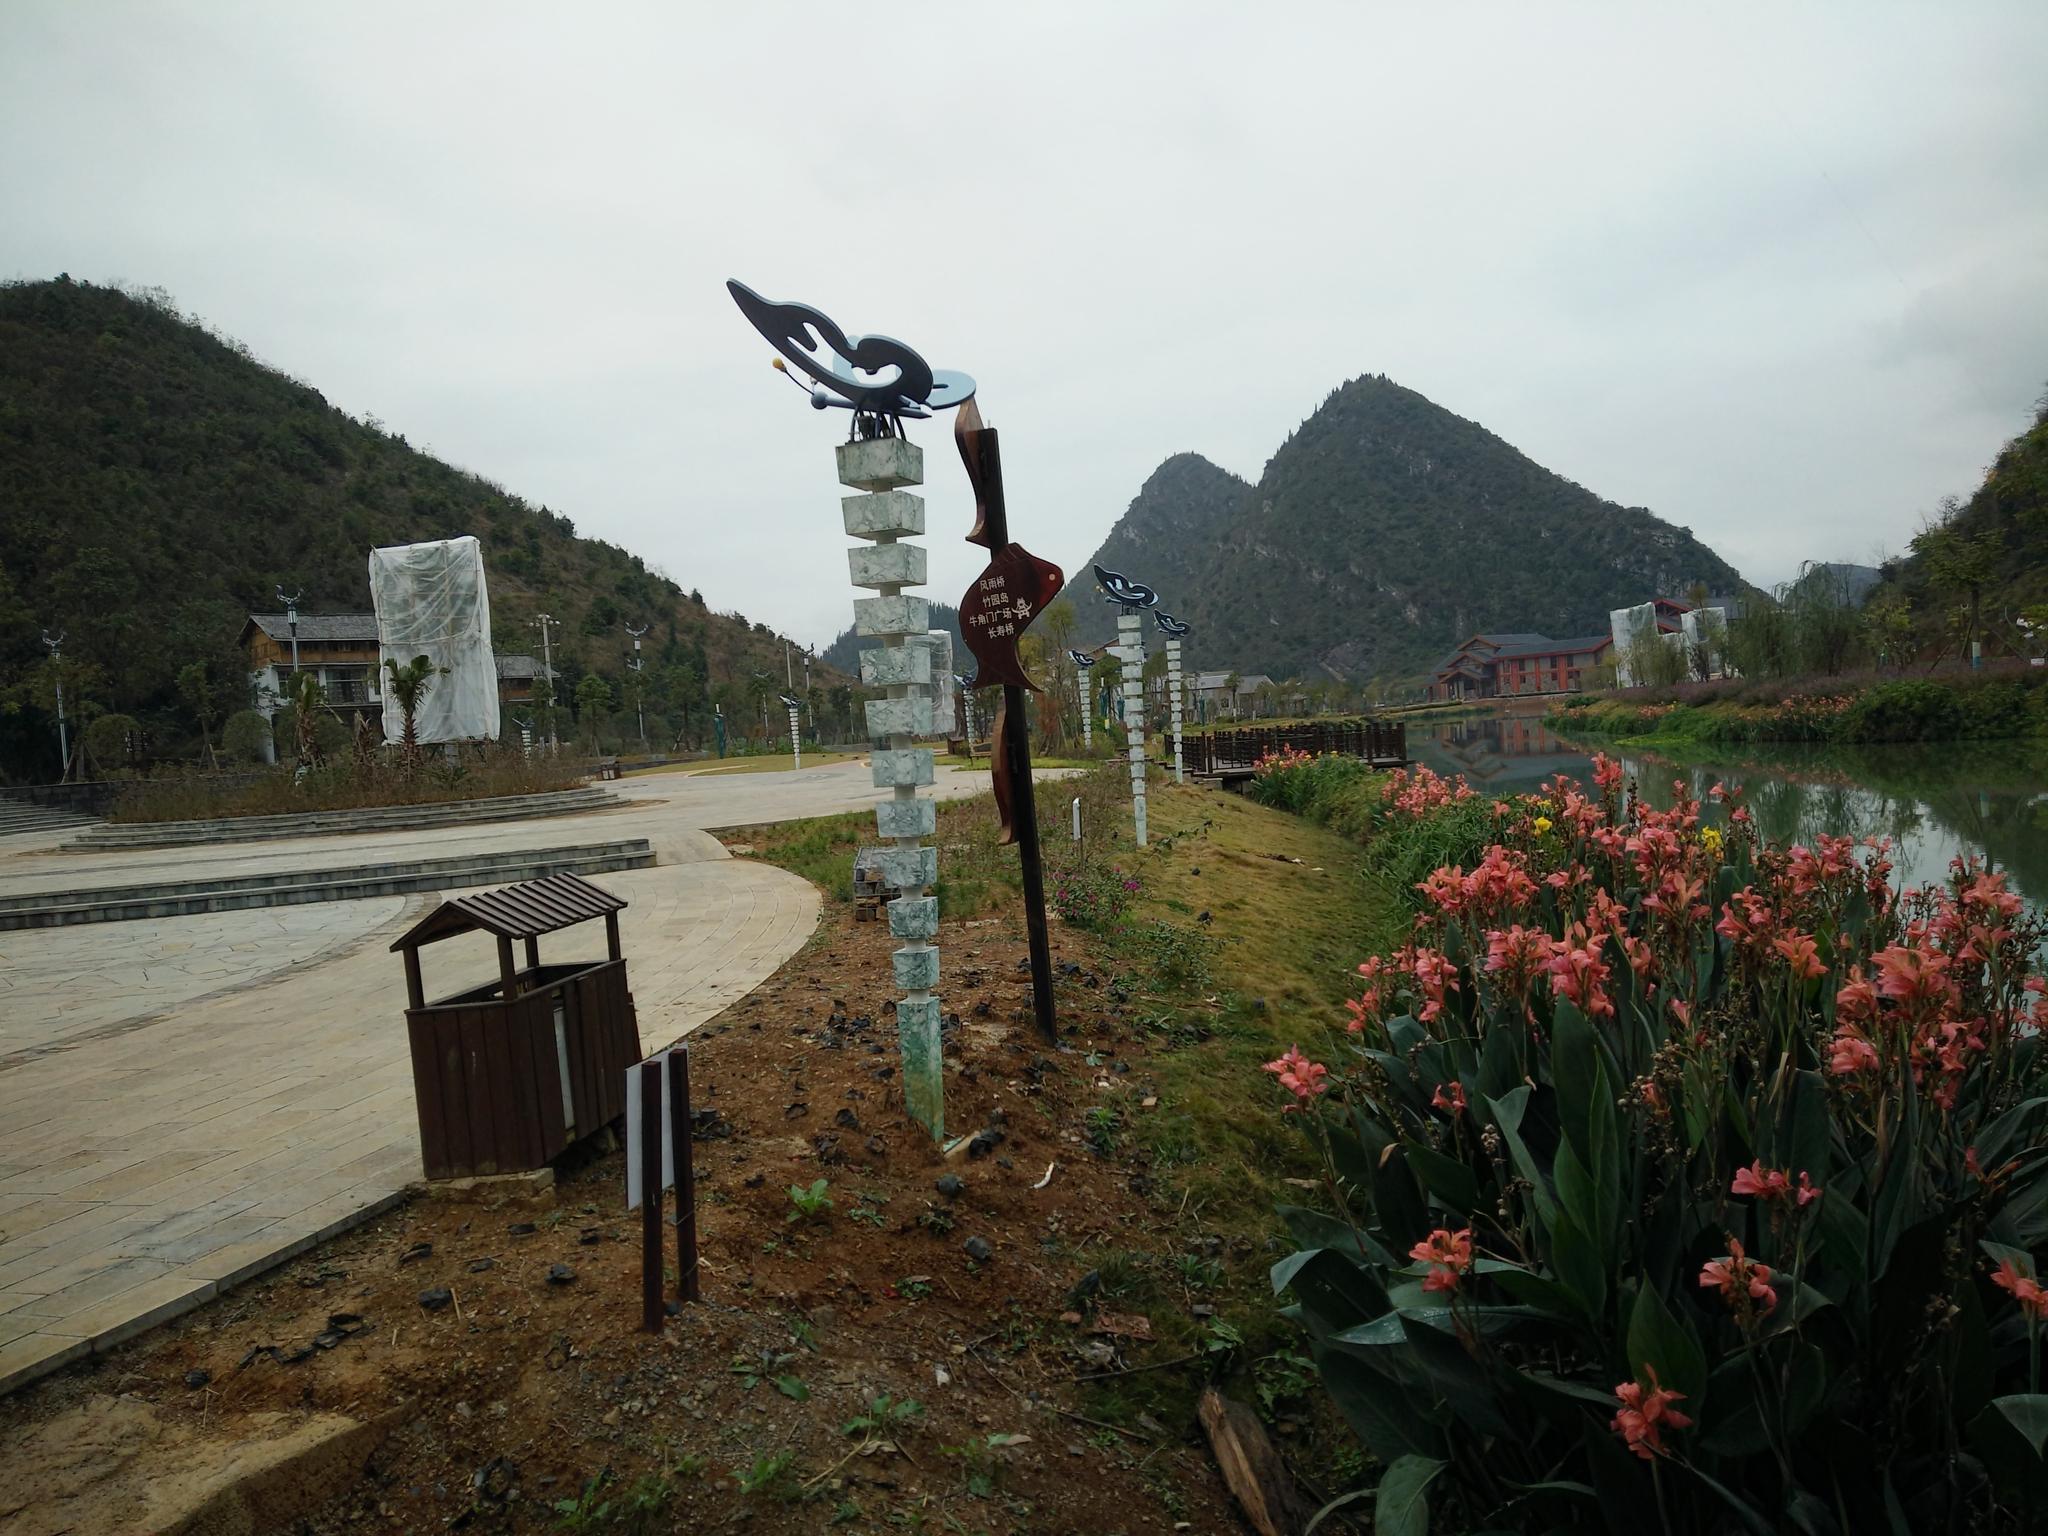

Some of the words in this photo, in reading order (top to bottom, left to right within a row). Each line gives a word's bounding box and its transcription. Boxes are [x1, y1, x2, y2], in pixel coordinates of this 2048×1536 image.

[979, 575, 1006, 592] 风雨桥
[982, 592, 1009, 608] 竹园岛
[969, 607, 1012, 628] 牛角门广场
[988, 622, 1015, 639] 长寿桥
